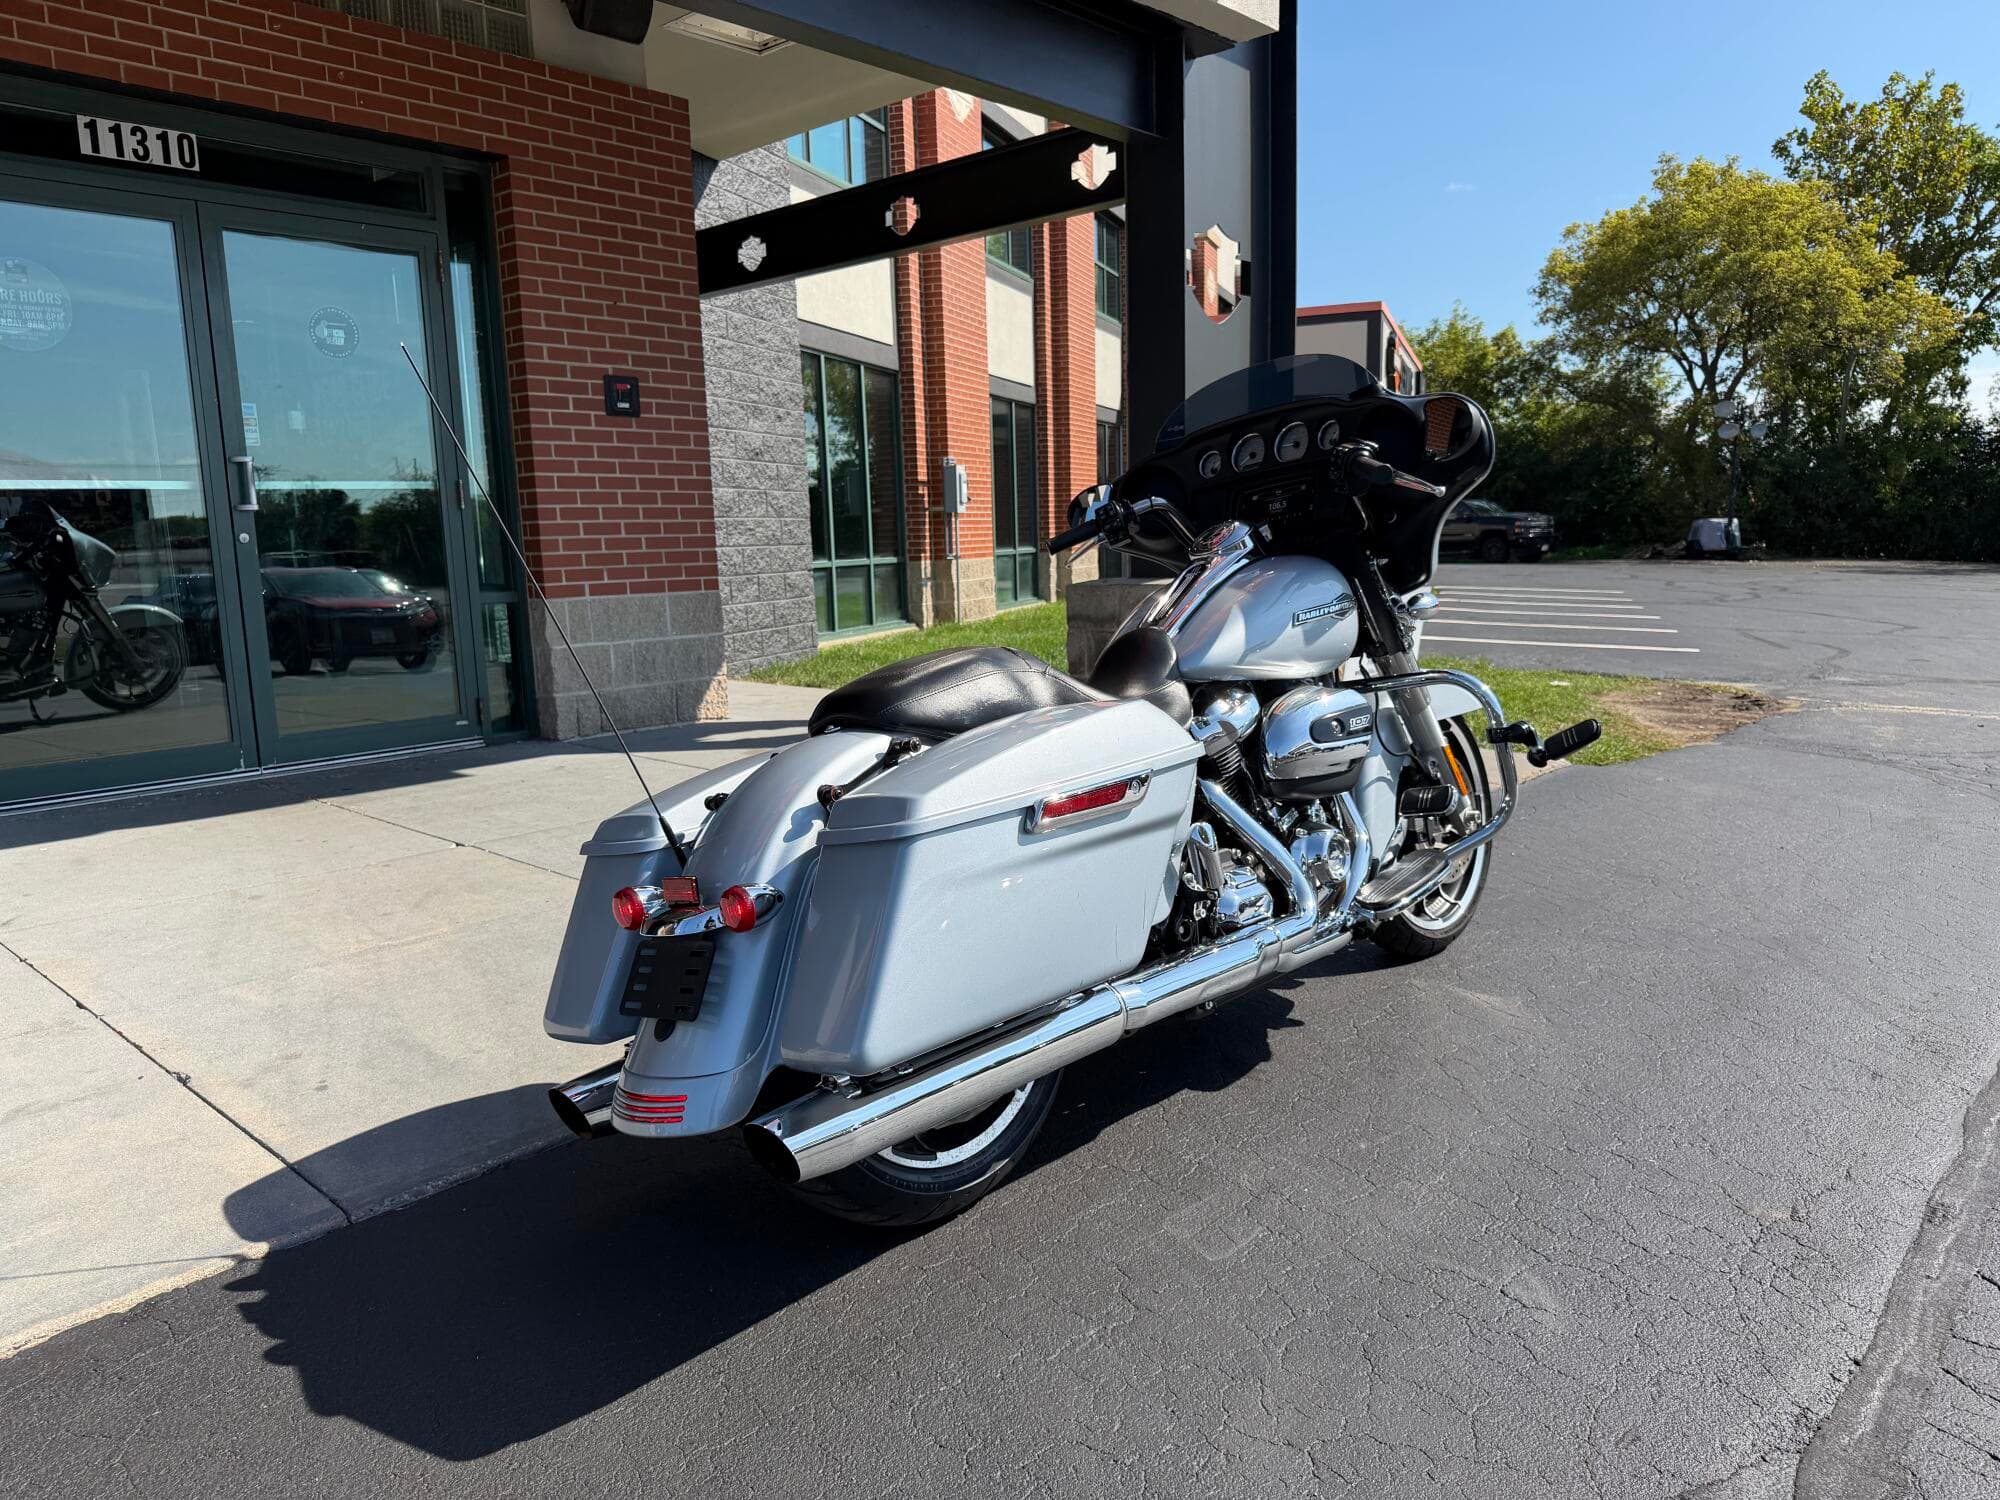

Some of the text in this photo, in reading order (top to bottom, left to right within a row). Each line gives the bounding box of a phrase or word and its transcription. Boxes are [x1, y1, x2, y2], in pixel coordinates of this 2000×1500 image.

[83, 118, 197, 169] 11310
[19, 289, 63, 305] HOURS
[1299, 601, 1355, 620] HARLEY-DAVID
[1349, 714, 1371, 728] 107
